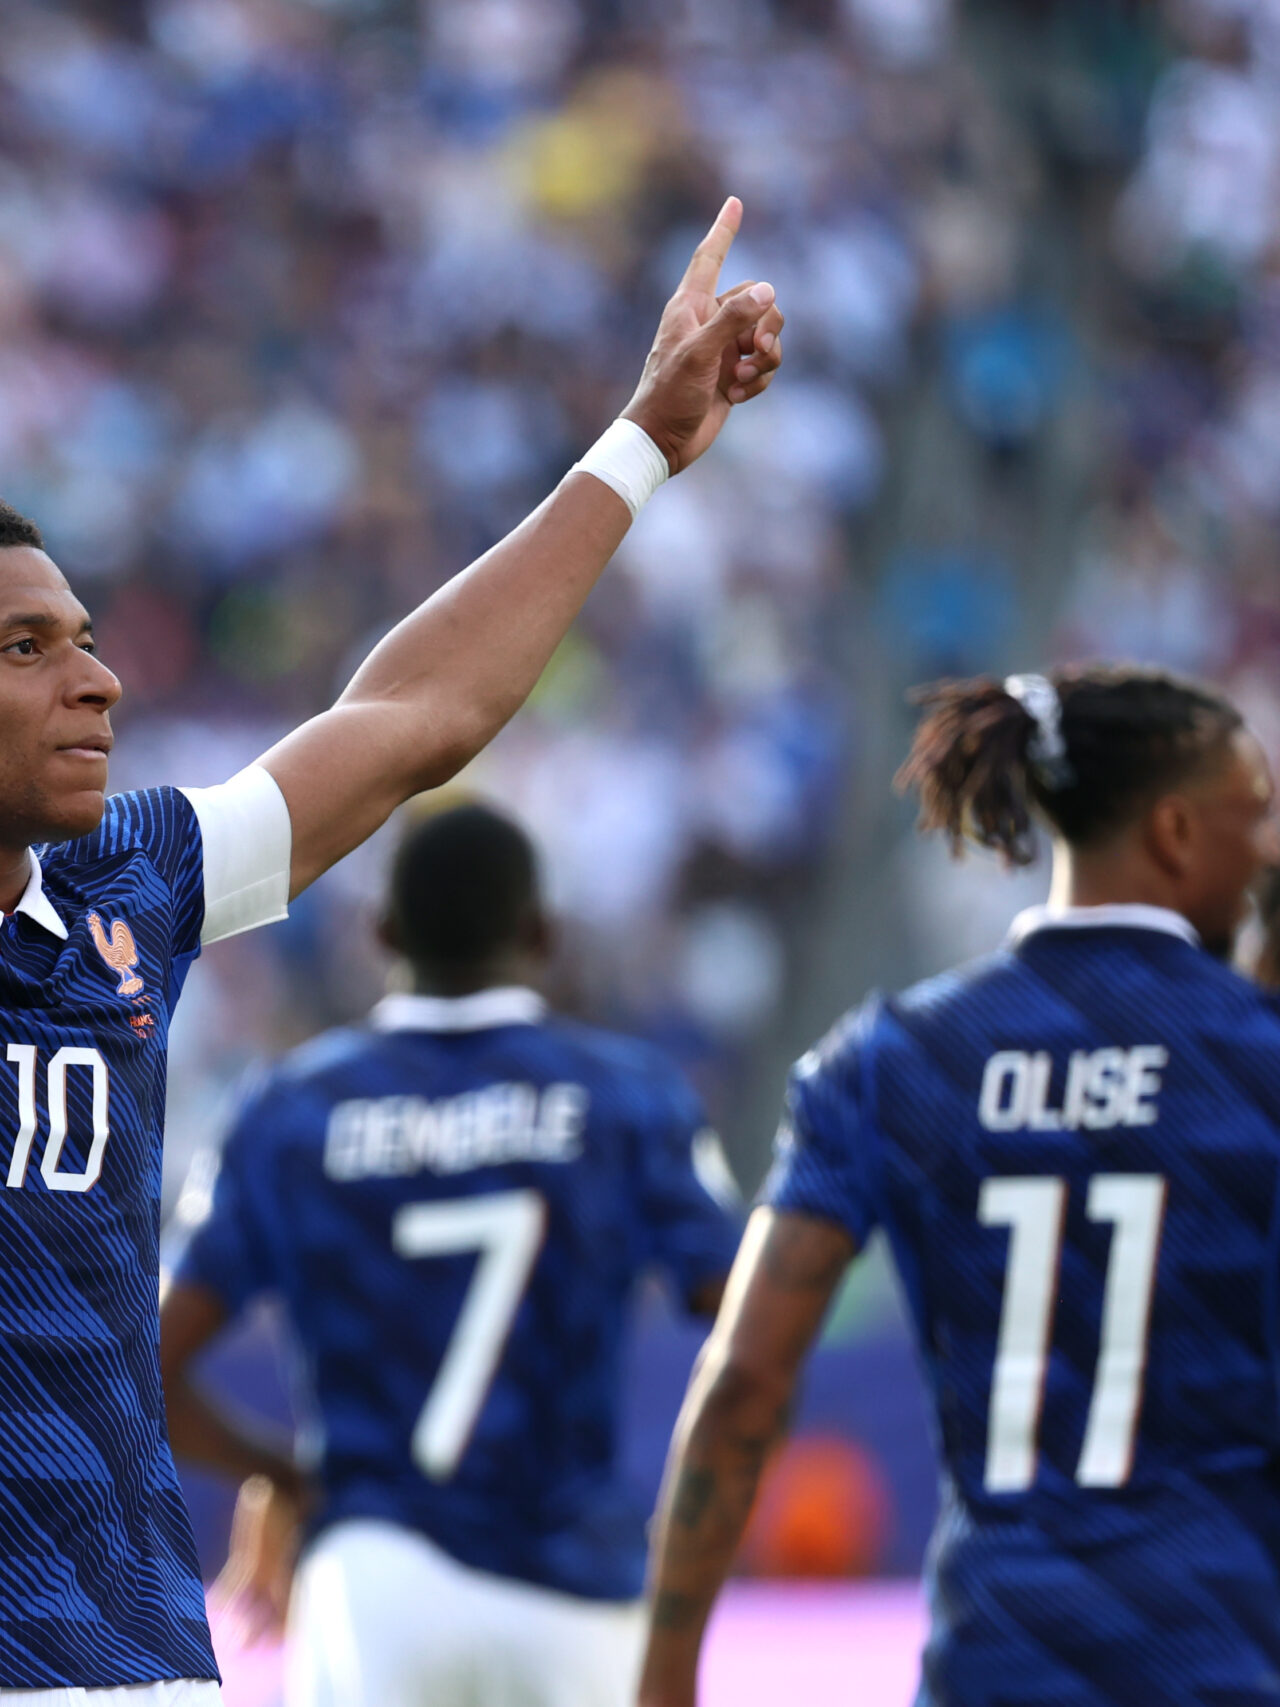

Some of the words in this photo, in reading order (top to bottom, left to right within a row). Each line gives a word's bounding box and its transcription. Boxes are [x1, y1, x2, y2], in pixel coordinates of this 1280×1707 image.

[129, 1013, 154, 1027] FRANCE
[979, 1045, 1168, 1132] OLISE
[7, 1043, 109, 1192] 10
[393, 1189, 547, 1484] 7
[977, 1173, 1167, 1493] 11
